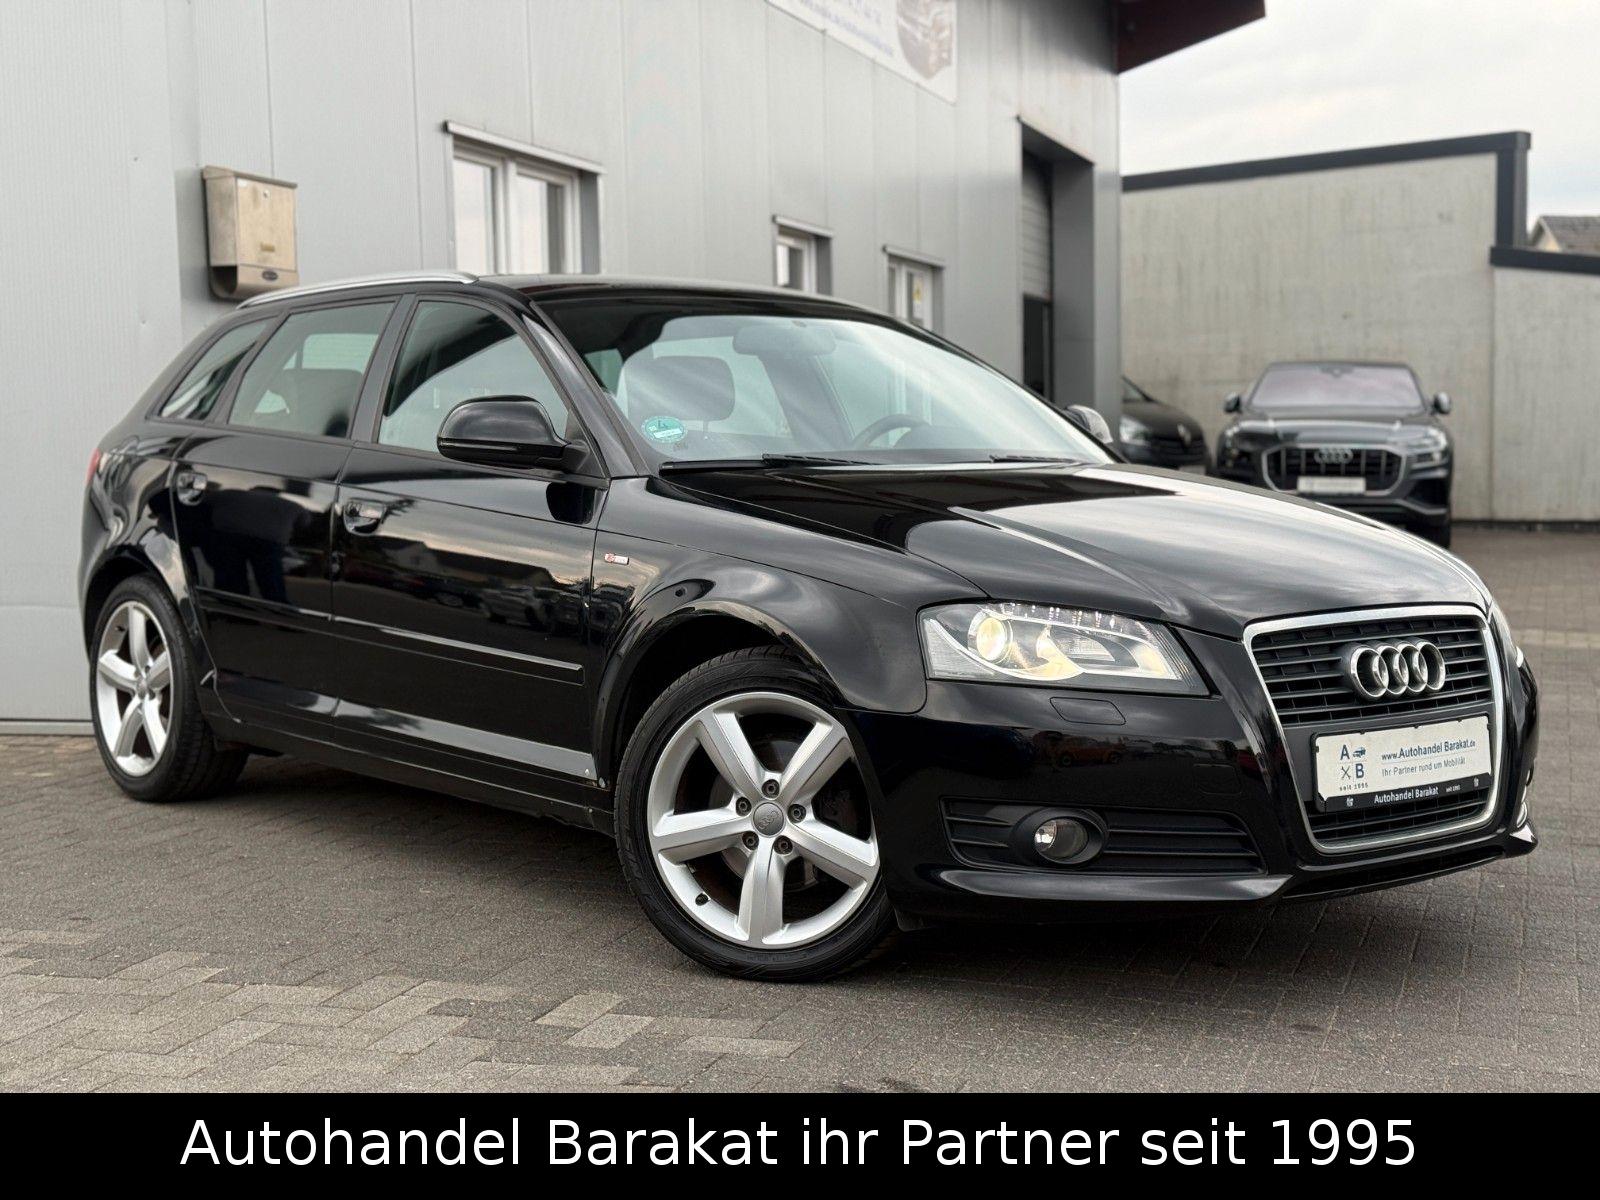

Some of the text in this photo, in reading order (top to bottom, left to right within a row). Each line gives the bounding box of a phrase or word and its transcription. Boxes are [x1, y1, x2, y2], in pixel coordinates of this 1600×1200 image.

[1340, 745, 1350, 760] A
[1444, 740, 1475, 752] Barakat.de
[1355, 763, 1364, 778] B
[1382, 767, 1391, 777] Ihr
[1394, 765, 1417, 775] Partner
[1419, 763, 1432, 771] rund
[1374, 792, 1414, 804] Autohandel
[1415, 786, 1439, 798] Barakat
